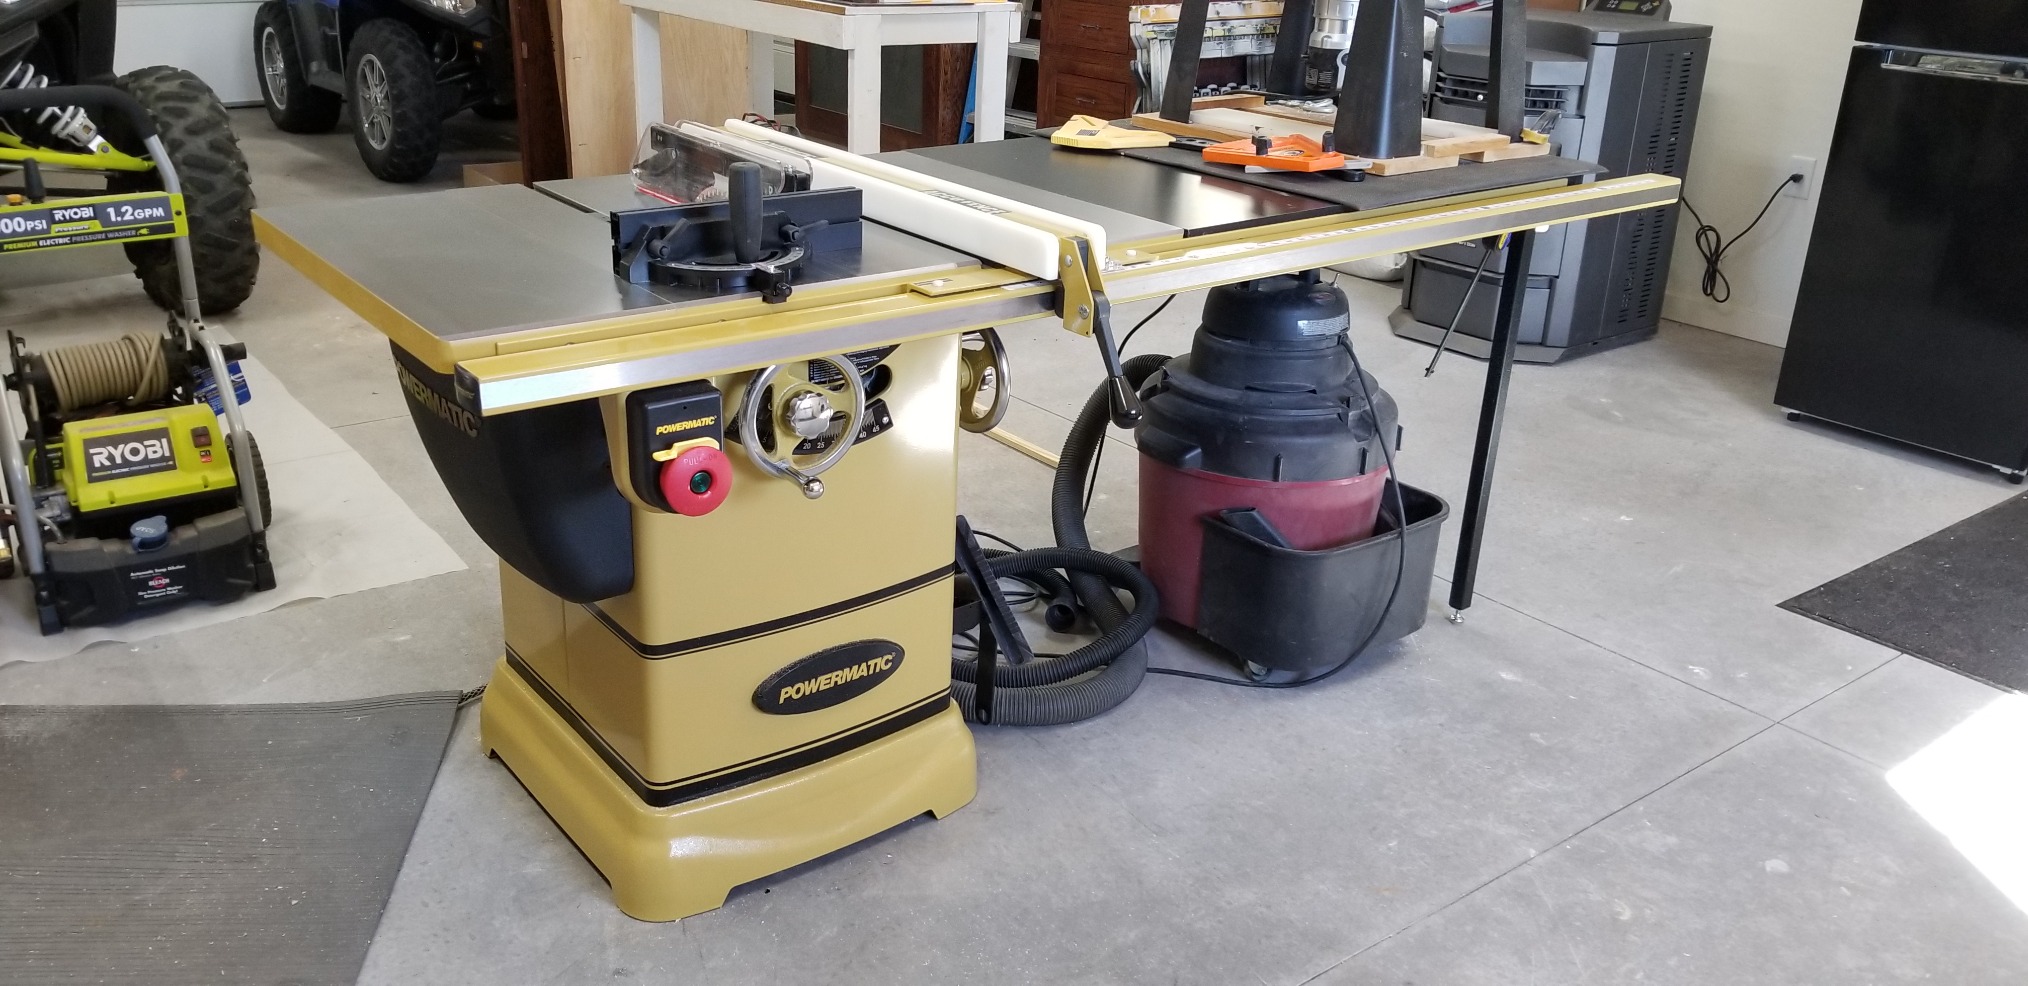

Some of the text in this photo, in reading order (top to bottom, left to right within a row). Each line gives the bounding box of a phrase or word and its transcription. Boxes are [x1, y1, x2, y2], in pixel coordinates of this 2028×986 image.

[52, 207, 94, 221] RYOBI
[3, 229, 137, 250] PREMIUM ELECTRIC PRESSURE WASHER
[655, 416, 715, 435] POWERMATIC
[858, 424, 881, 439] 40 45
[88, 437, 171, 468] RYOBI
[803, 440, 825, 450] 20 25
[778, 654, 893, 705] POWERMATIC
